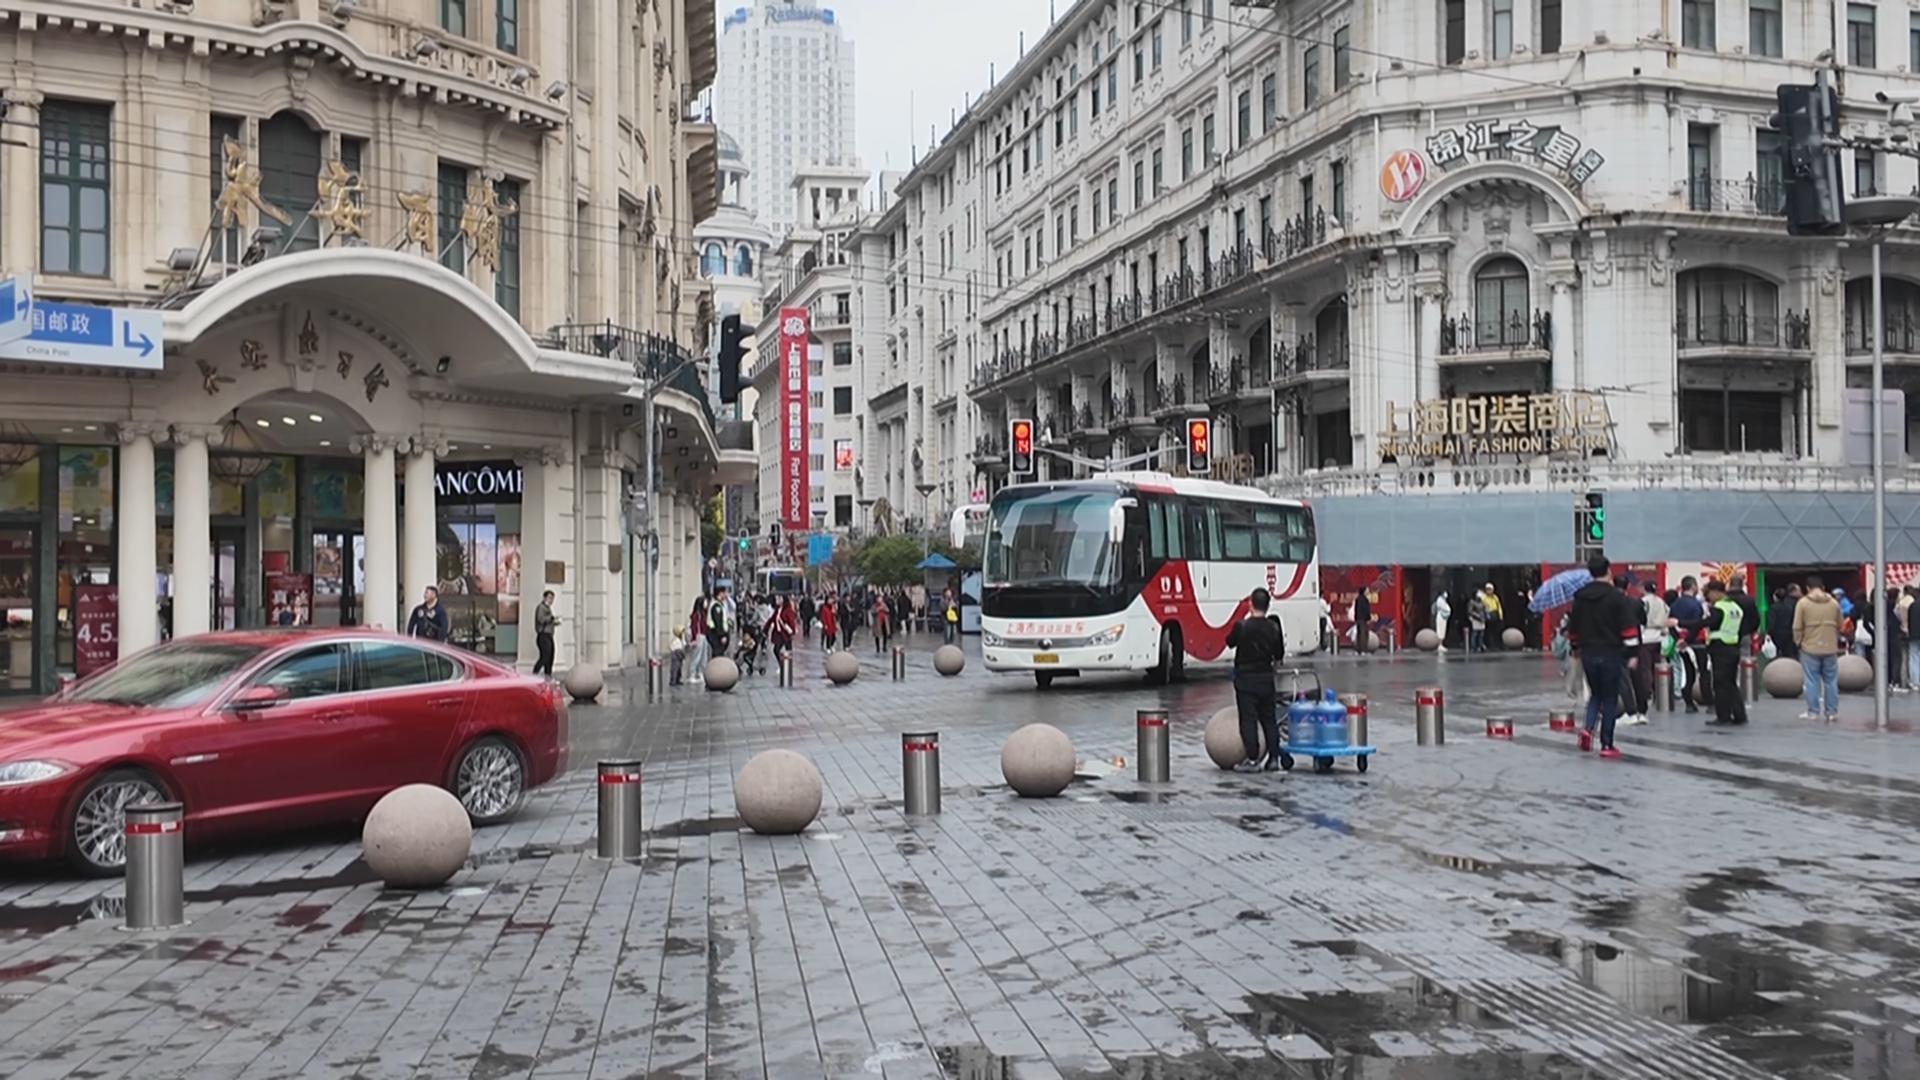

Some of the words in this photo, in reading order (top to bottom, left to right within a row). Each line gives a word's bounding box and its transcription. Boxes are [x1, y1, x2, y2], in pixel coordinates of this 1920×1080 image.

[1427, 119, 1580, 169] 锦江之星
[1194, 439, 1206, 453] 14
[1379, 438, 1461, 457] SHANGHAI
[1469, 436, 1542, 454] FASHION
